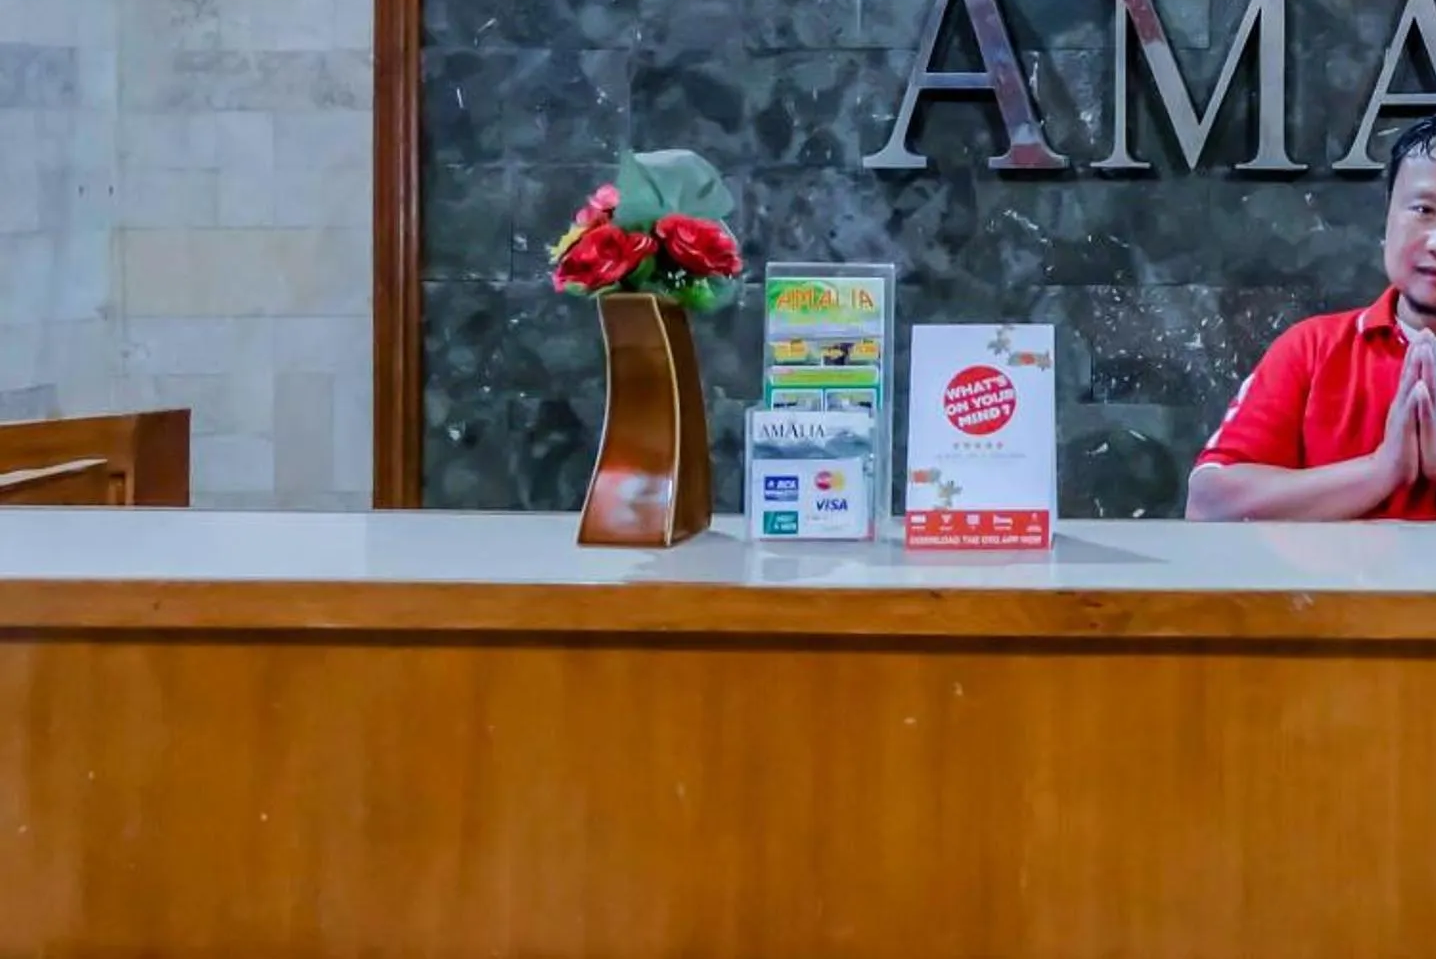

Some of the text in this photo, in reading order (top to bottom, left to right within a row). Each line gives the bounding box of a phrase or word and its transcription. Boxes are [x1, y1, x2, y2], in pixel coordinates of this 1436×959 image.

[946, 375, 1008, 401] WHAT'S
[946, 388, 1015, 416] ON YOUR
[760, 423, 825, 438] AMALIA
[816, 498, 849, 511] VISA
